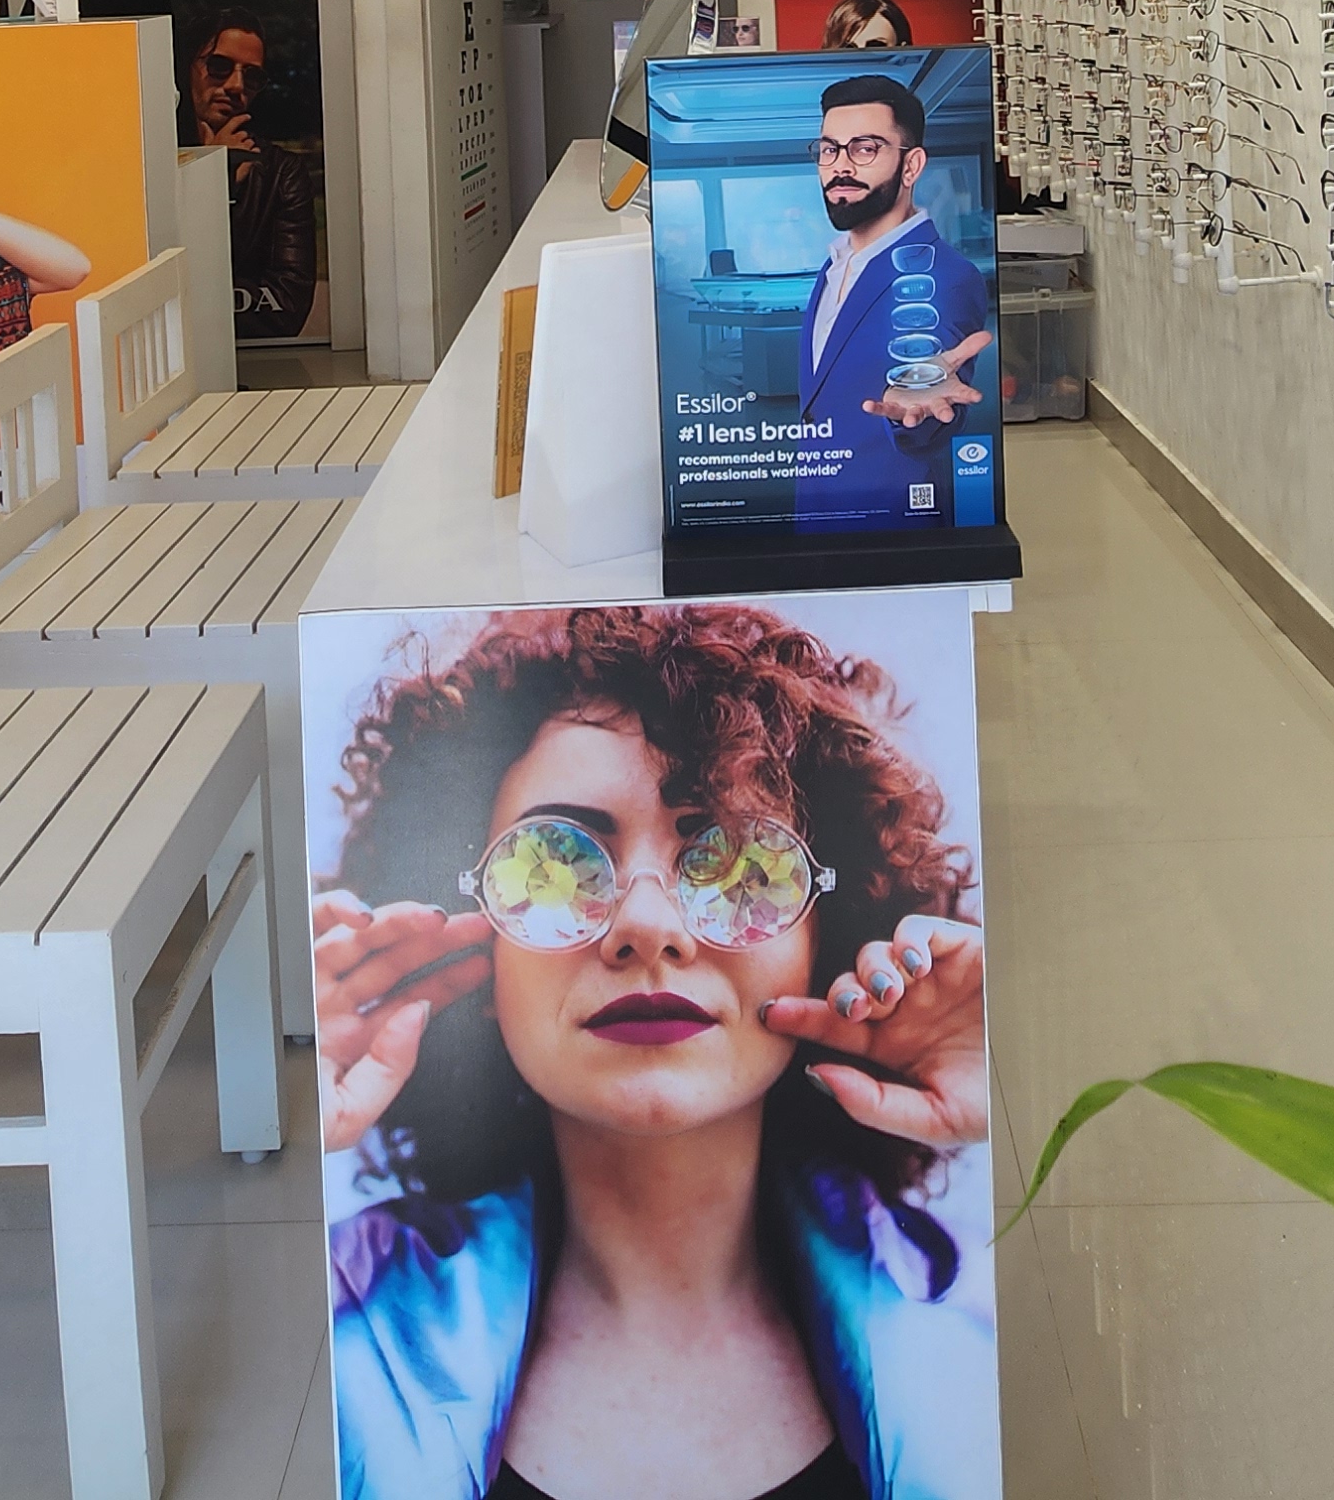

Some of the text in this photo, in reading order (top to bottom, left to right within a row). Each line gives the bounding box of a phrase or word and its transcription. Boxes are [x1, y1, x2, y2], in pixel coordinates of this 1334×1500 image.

[463, 1, 475, 42] E
[678, 418, 834, 444] #1 lens brand
[678, 448, 853, 467] recommended by eye care
[678, 466, 768, 485] professionals
[957, 465, 989, 477] essilor
